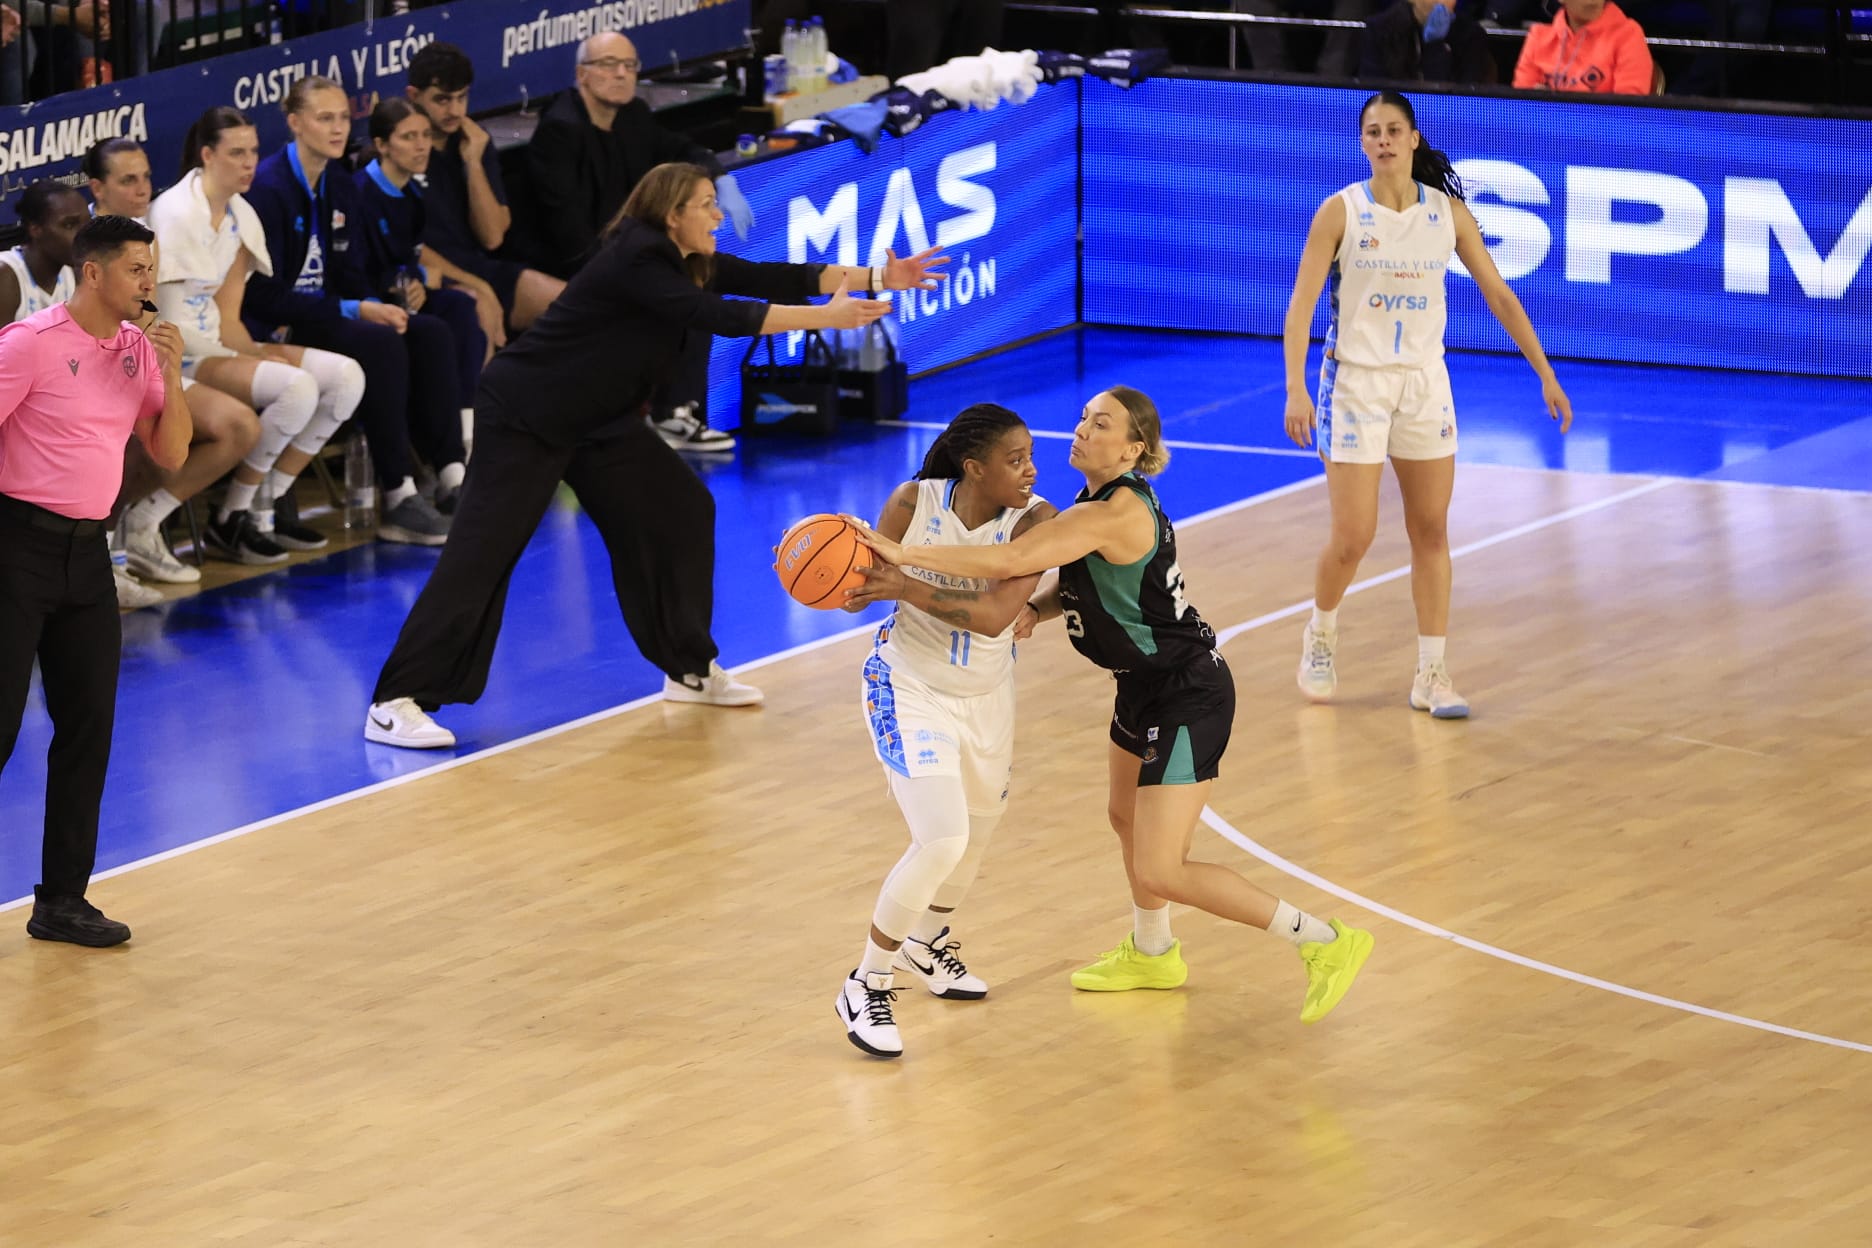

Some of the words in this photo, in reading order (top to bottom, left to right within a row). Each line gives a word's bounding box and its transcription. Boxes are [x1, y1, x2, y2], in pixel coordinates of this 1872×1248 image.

[352, 47, 368, 89] Y
[0, 102, 148, 175] SALAMANCA
[787, 141, 997, 268] MAS
[1355, 260, 1407, 270] CASTILLA
[1413, 260, 1420, 271] Y
[1394, 320, 1402, 353] 1
[911, 566, 967, 588] CASTILLA
[1063, 608, 1085, 638] 3
[950, 630, 971, 666] 11
